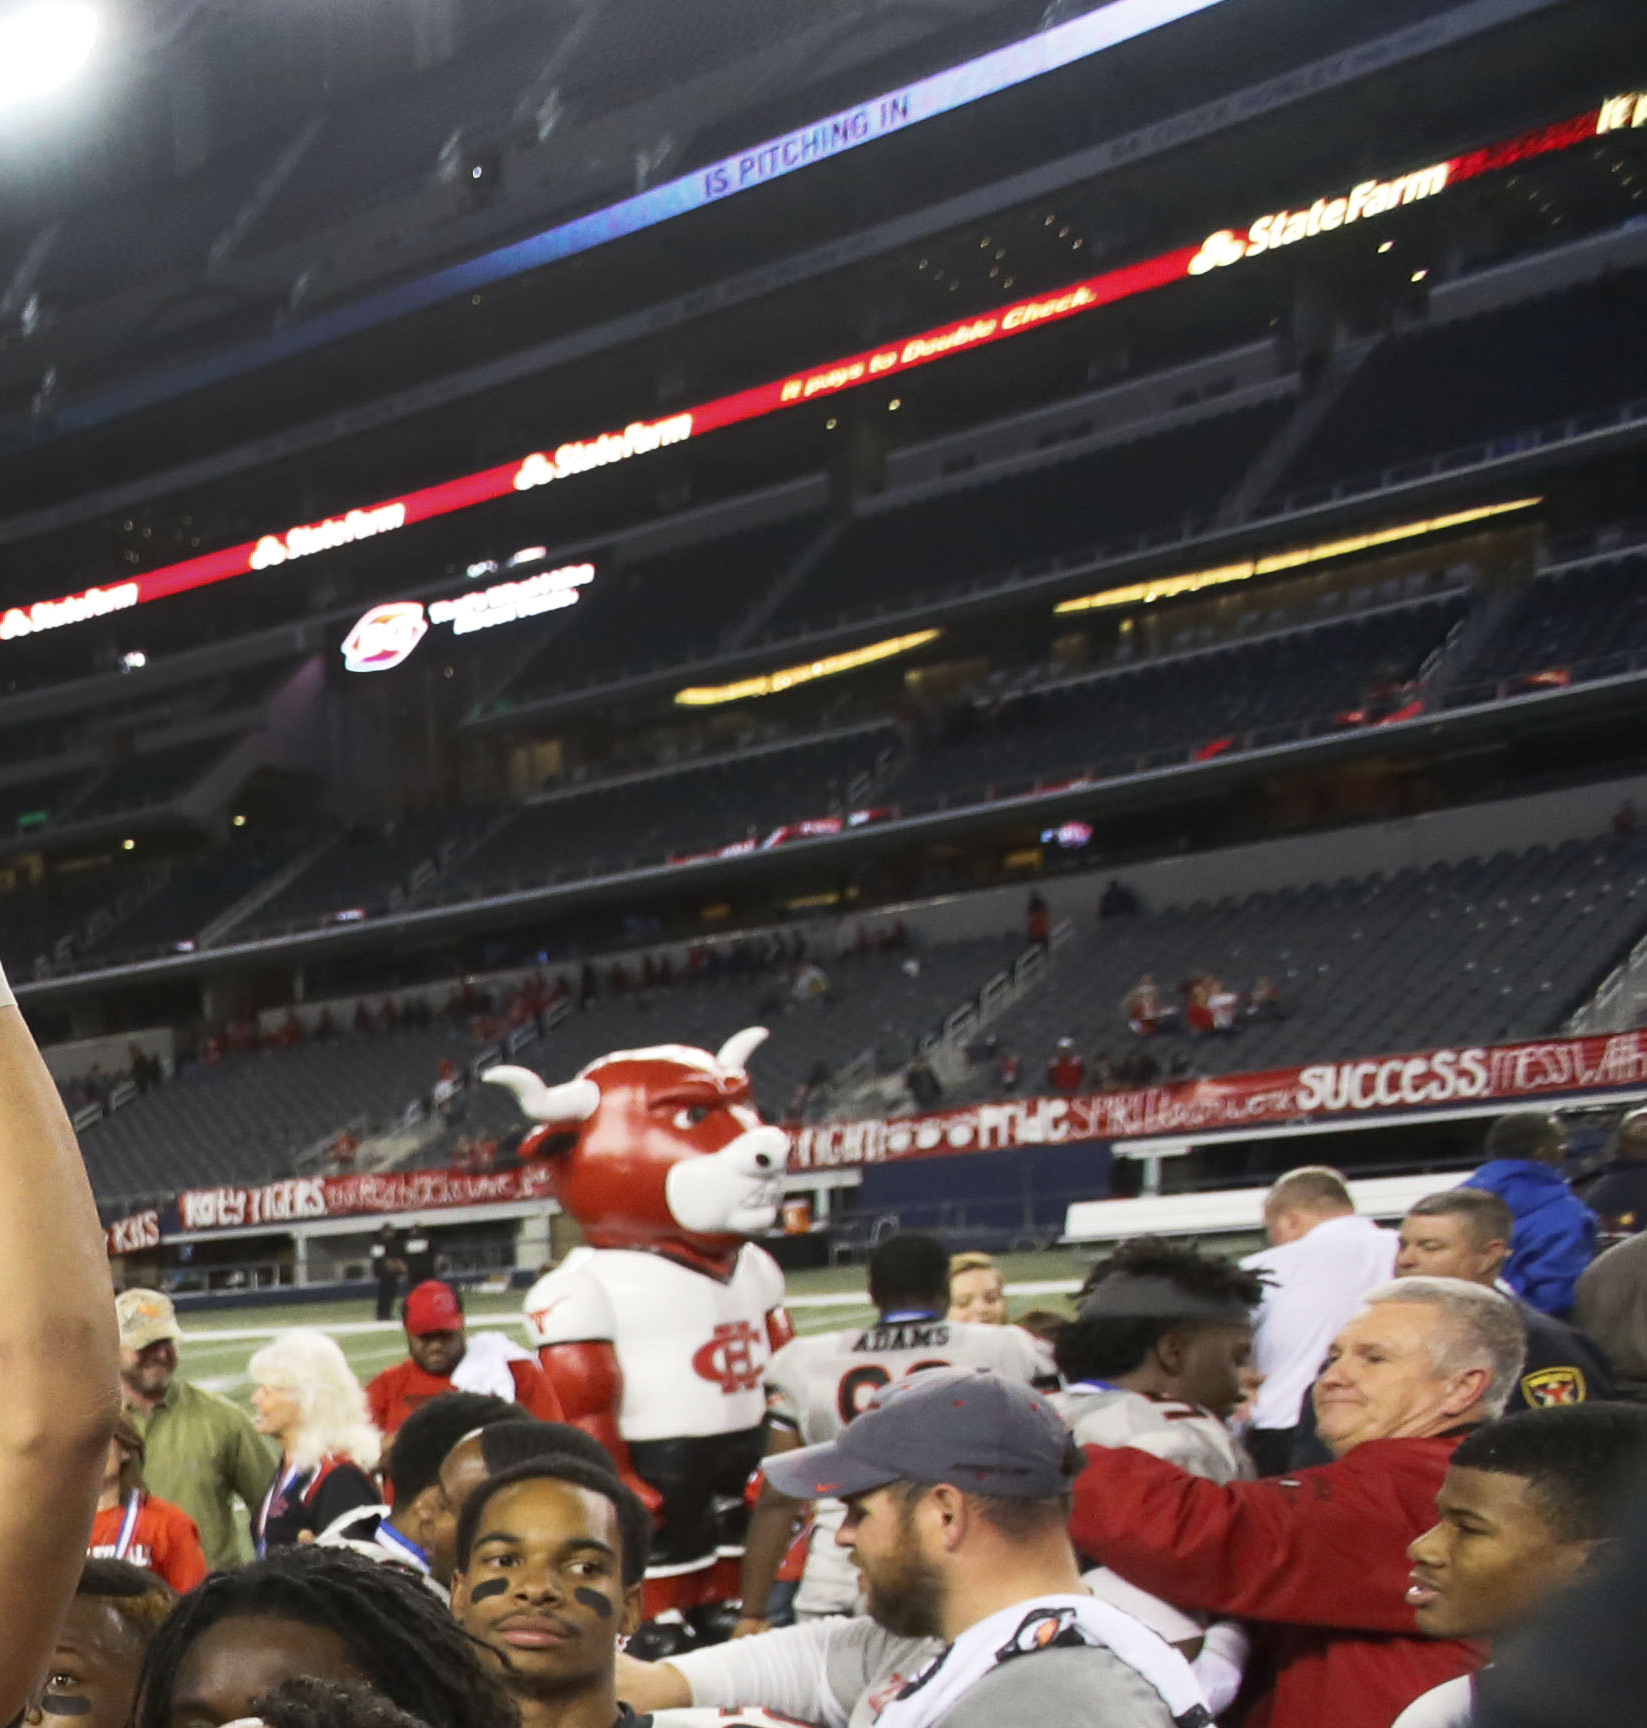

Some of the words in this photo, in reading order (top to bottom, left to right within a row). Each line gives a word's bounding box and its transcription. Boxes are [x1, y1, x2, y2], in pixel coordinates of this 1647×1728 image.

[705, 167, 729, 198] IS
[739, 111, 869, 185] PITCHING
[880, 95, 909, 129] IN
[900, 318, 998, 364] Double
[851, 1325, 951, 1352] ADAMS
